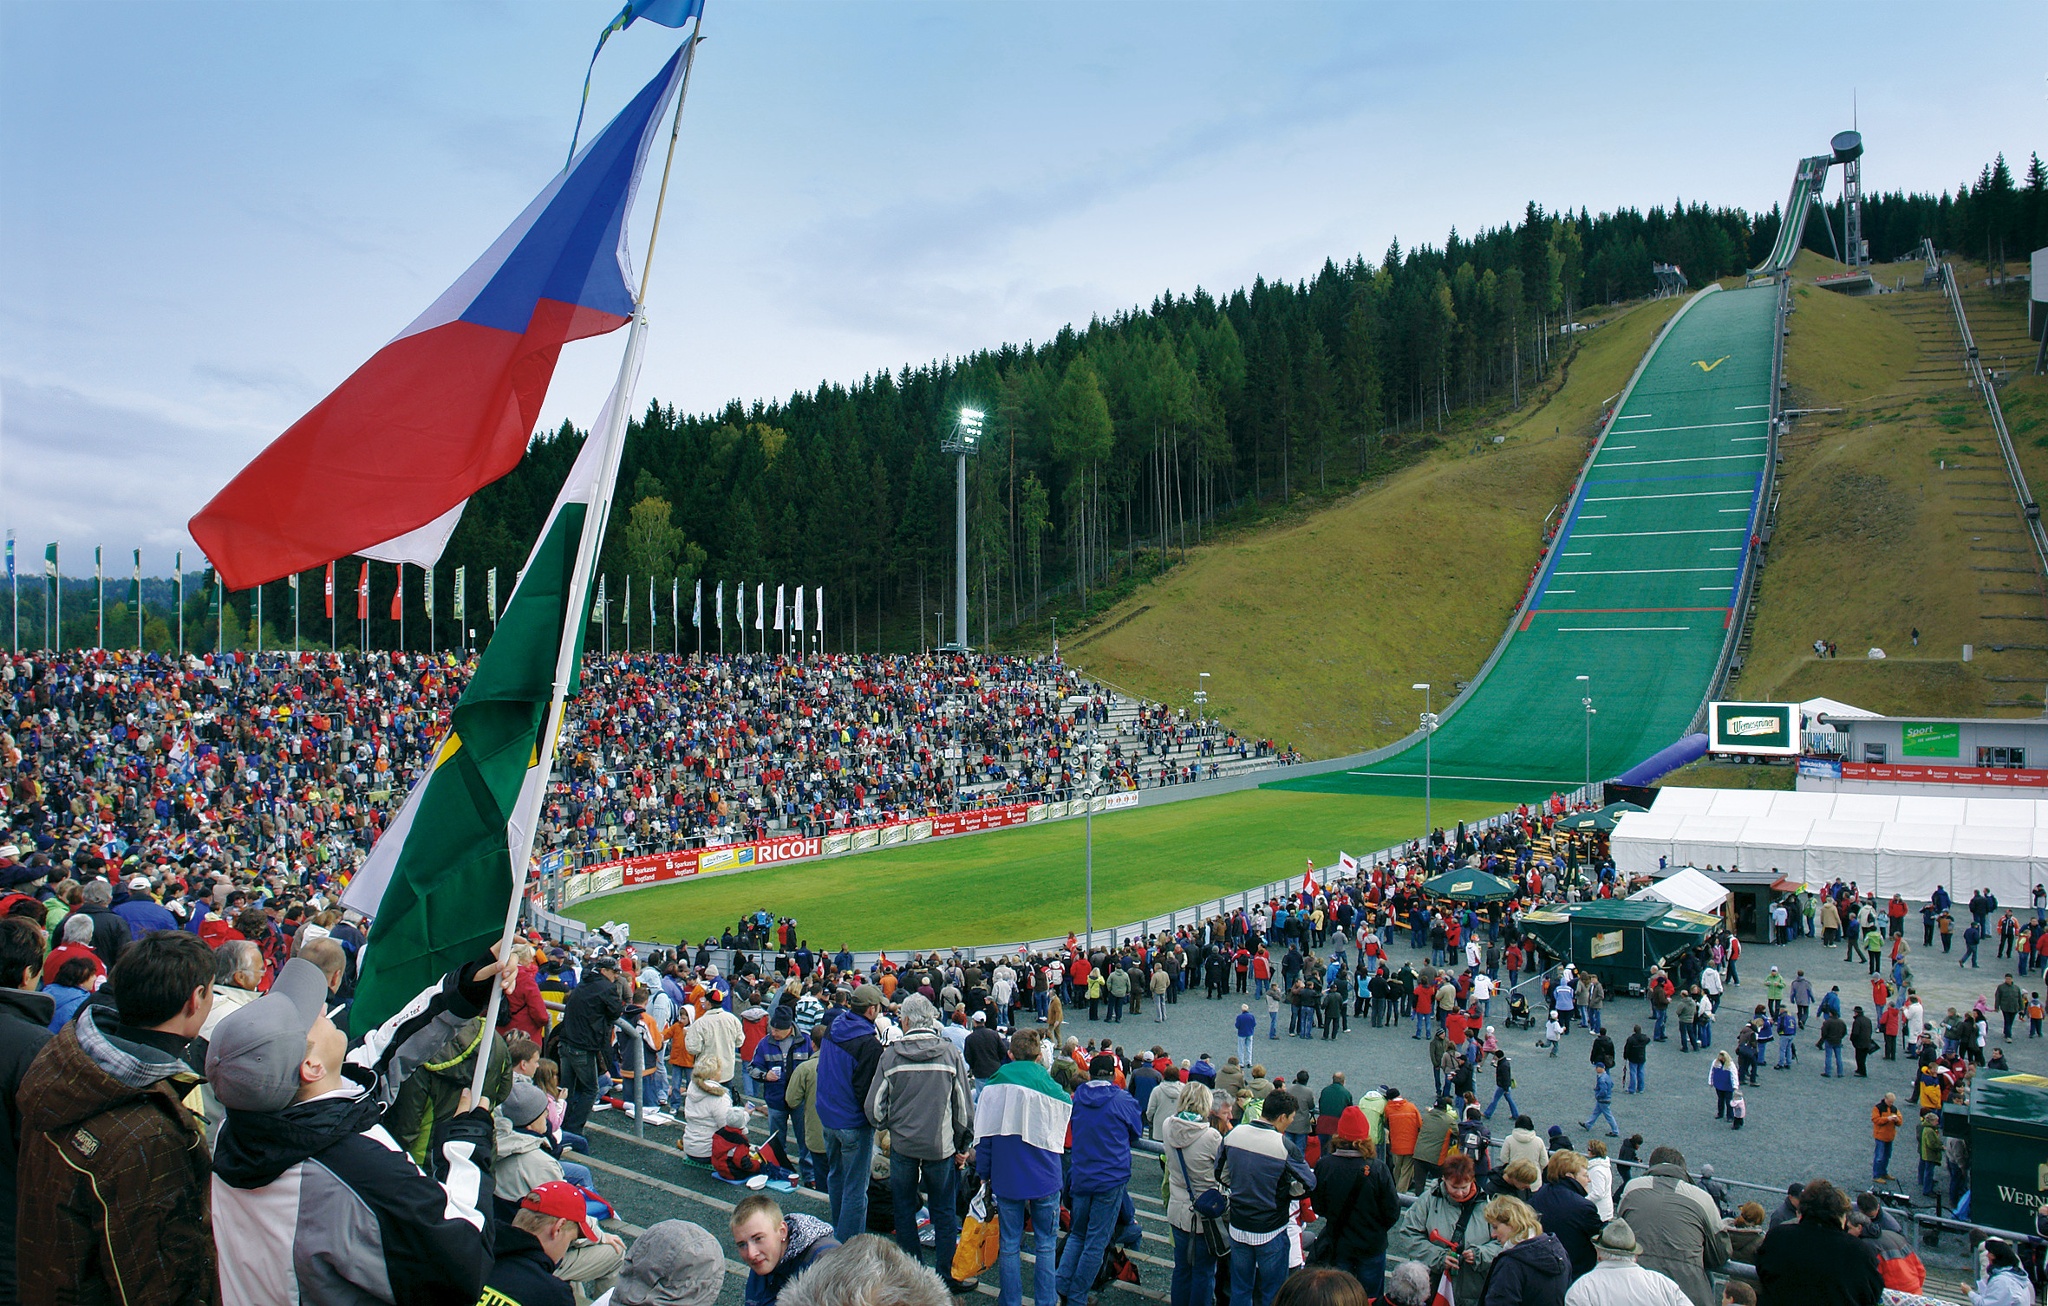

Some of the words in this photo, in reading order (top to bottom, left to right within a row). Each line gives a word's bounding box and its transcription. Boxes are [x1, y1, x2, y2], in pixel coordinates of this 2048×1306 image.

[1907, 725, 1933, 737] Sport
[758, 840, 818, 862] RICOH
[674, 860, 697, 869] Sparkasse
[634, 866, 657, 874] Sparkasse
[674, 868, 695, 876] Vogtland
[634, 874, 655, 883] Vogtland
[1997, 1185, 2048, 1207] WERN
